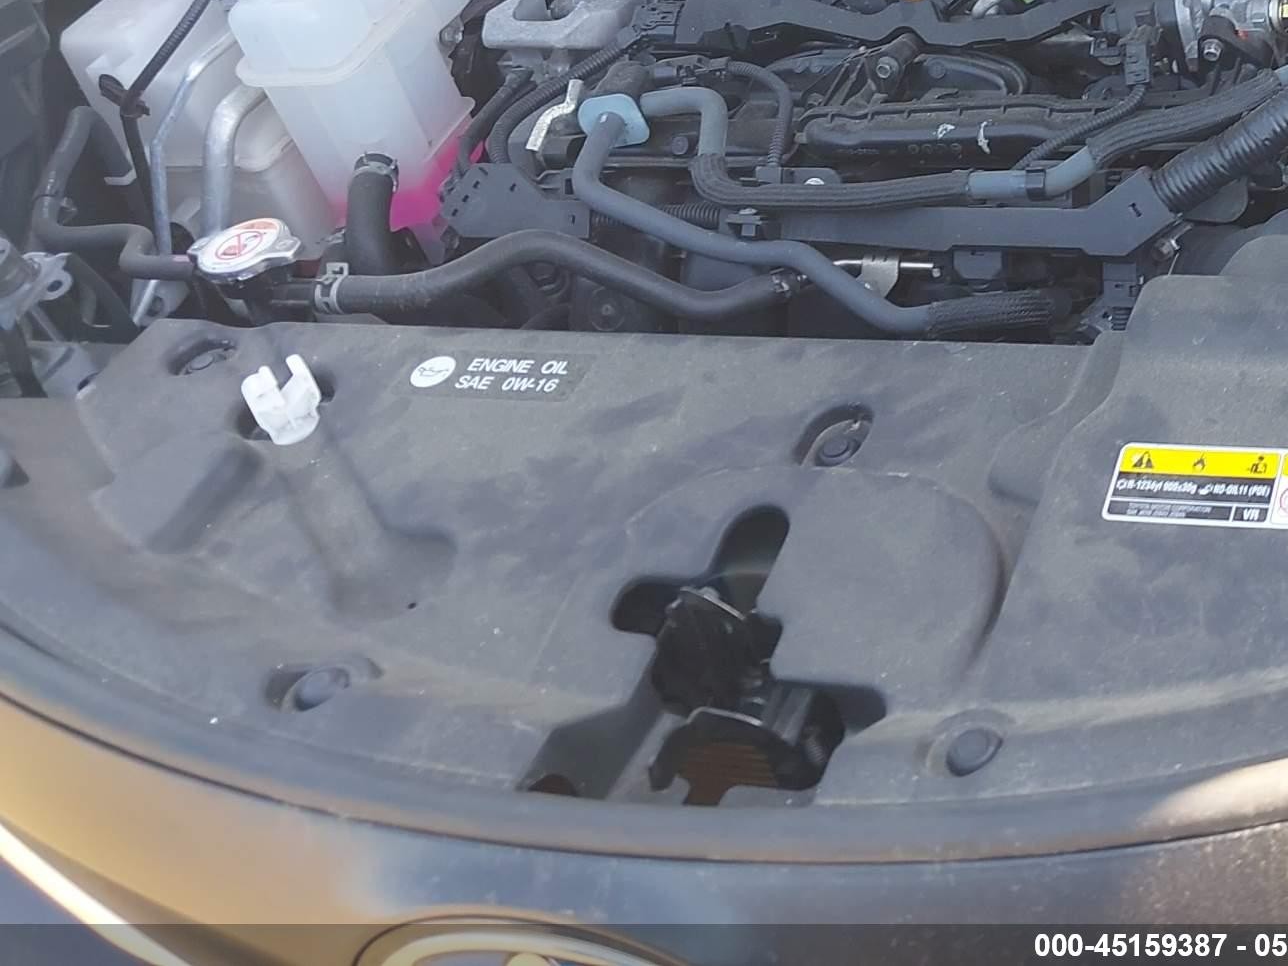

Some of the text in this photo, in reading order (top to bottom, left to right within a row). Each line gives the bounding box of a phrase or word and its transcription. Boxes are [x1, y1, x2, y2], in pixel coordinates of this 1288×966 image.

[467, 357, 568, 375] ENGINE OIL
[454, 375, 560, 392] SAE 0W-16
